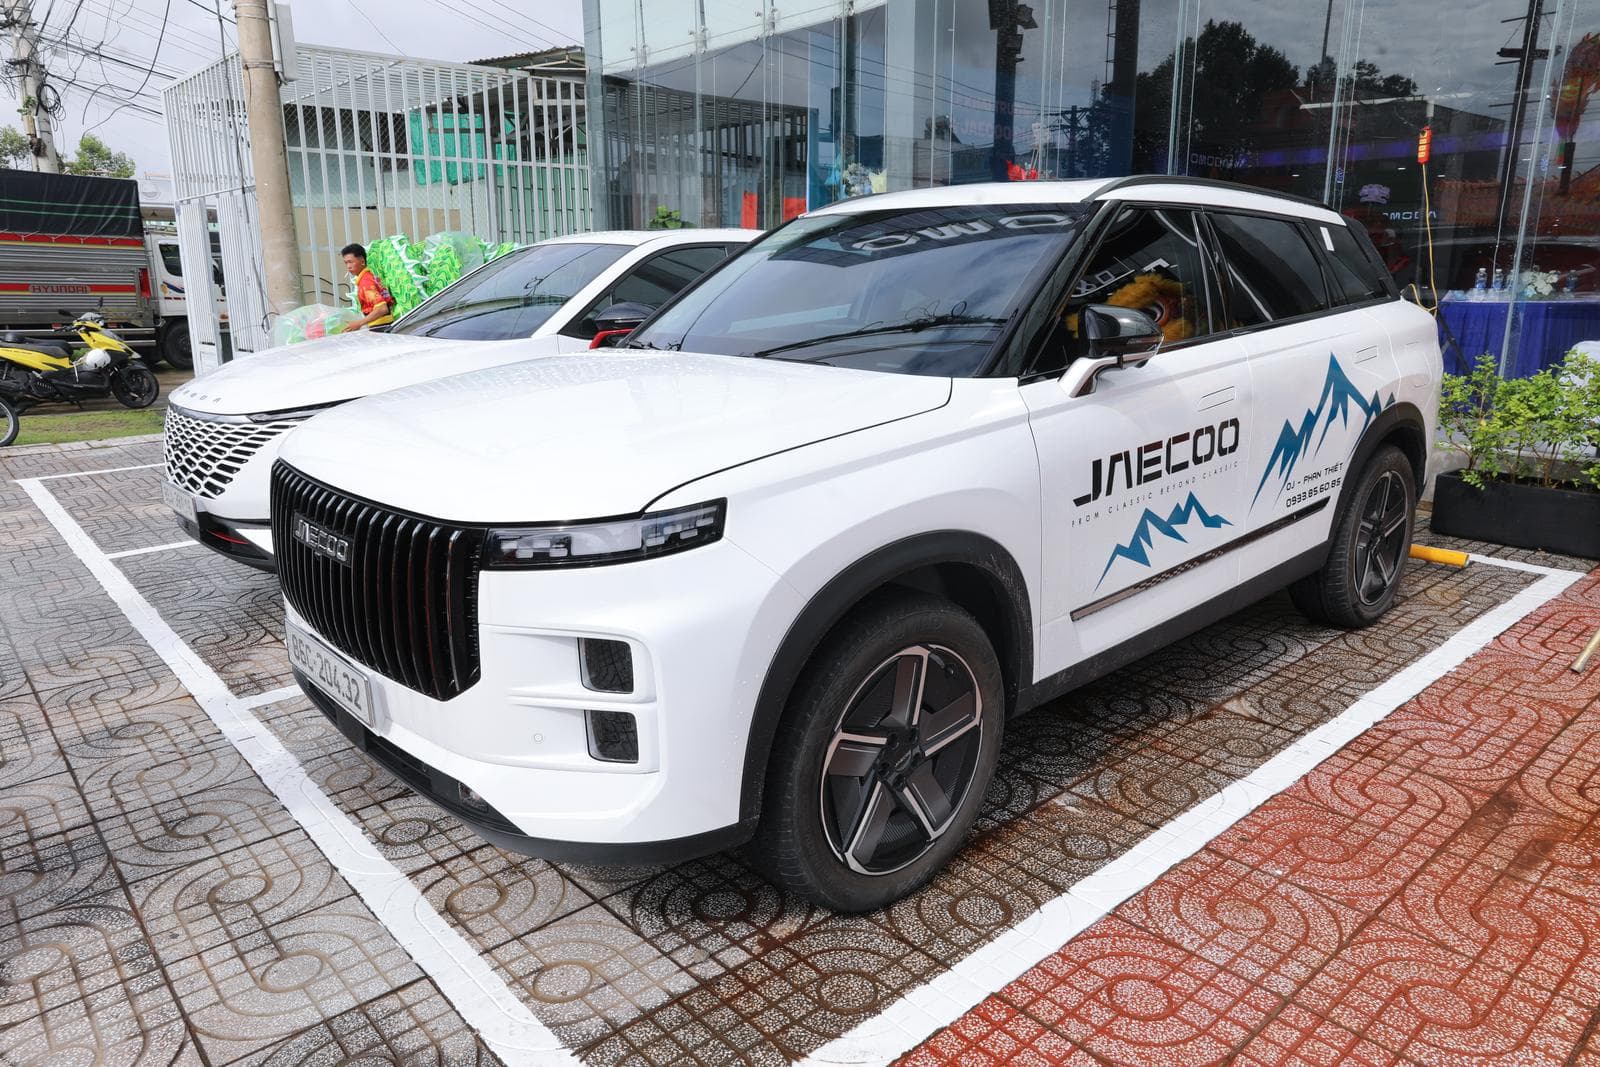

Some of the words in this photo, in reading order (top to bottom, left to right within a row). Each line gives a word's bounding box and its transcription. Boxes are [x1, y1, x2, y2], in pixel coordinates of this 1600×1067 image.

[31, 284, 88, 294] HYUNDAI
[1073, 417, 1240, 507] JAECOO
[1303, 471, 1322, 485] PHAN
[1108, 492, 1152, 514] CLASSIC
[1202, 461, 1238, 479] CLASSIC
[295, 519, 349, 562] JAECOO
